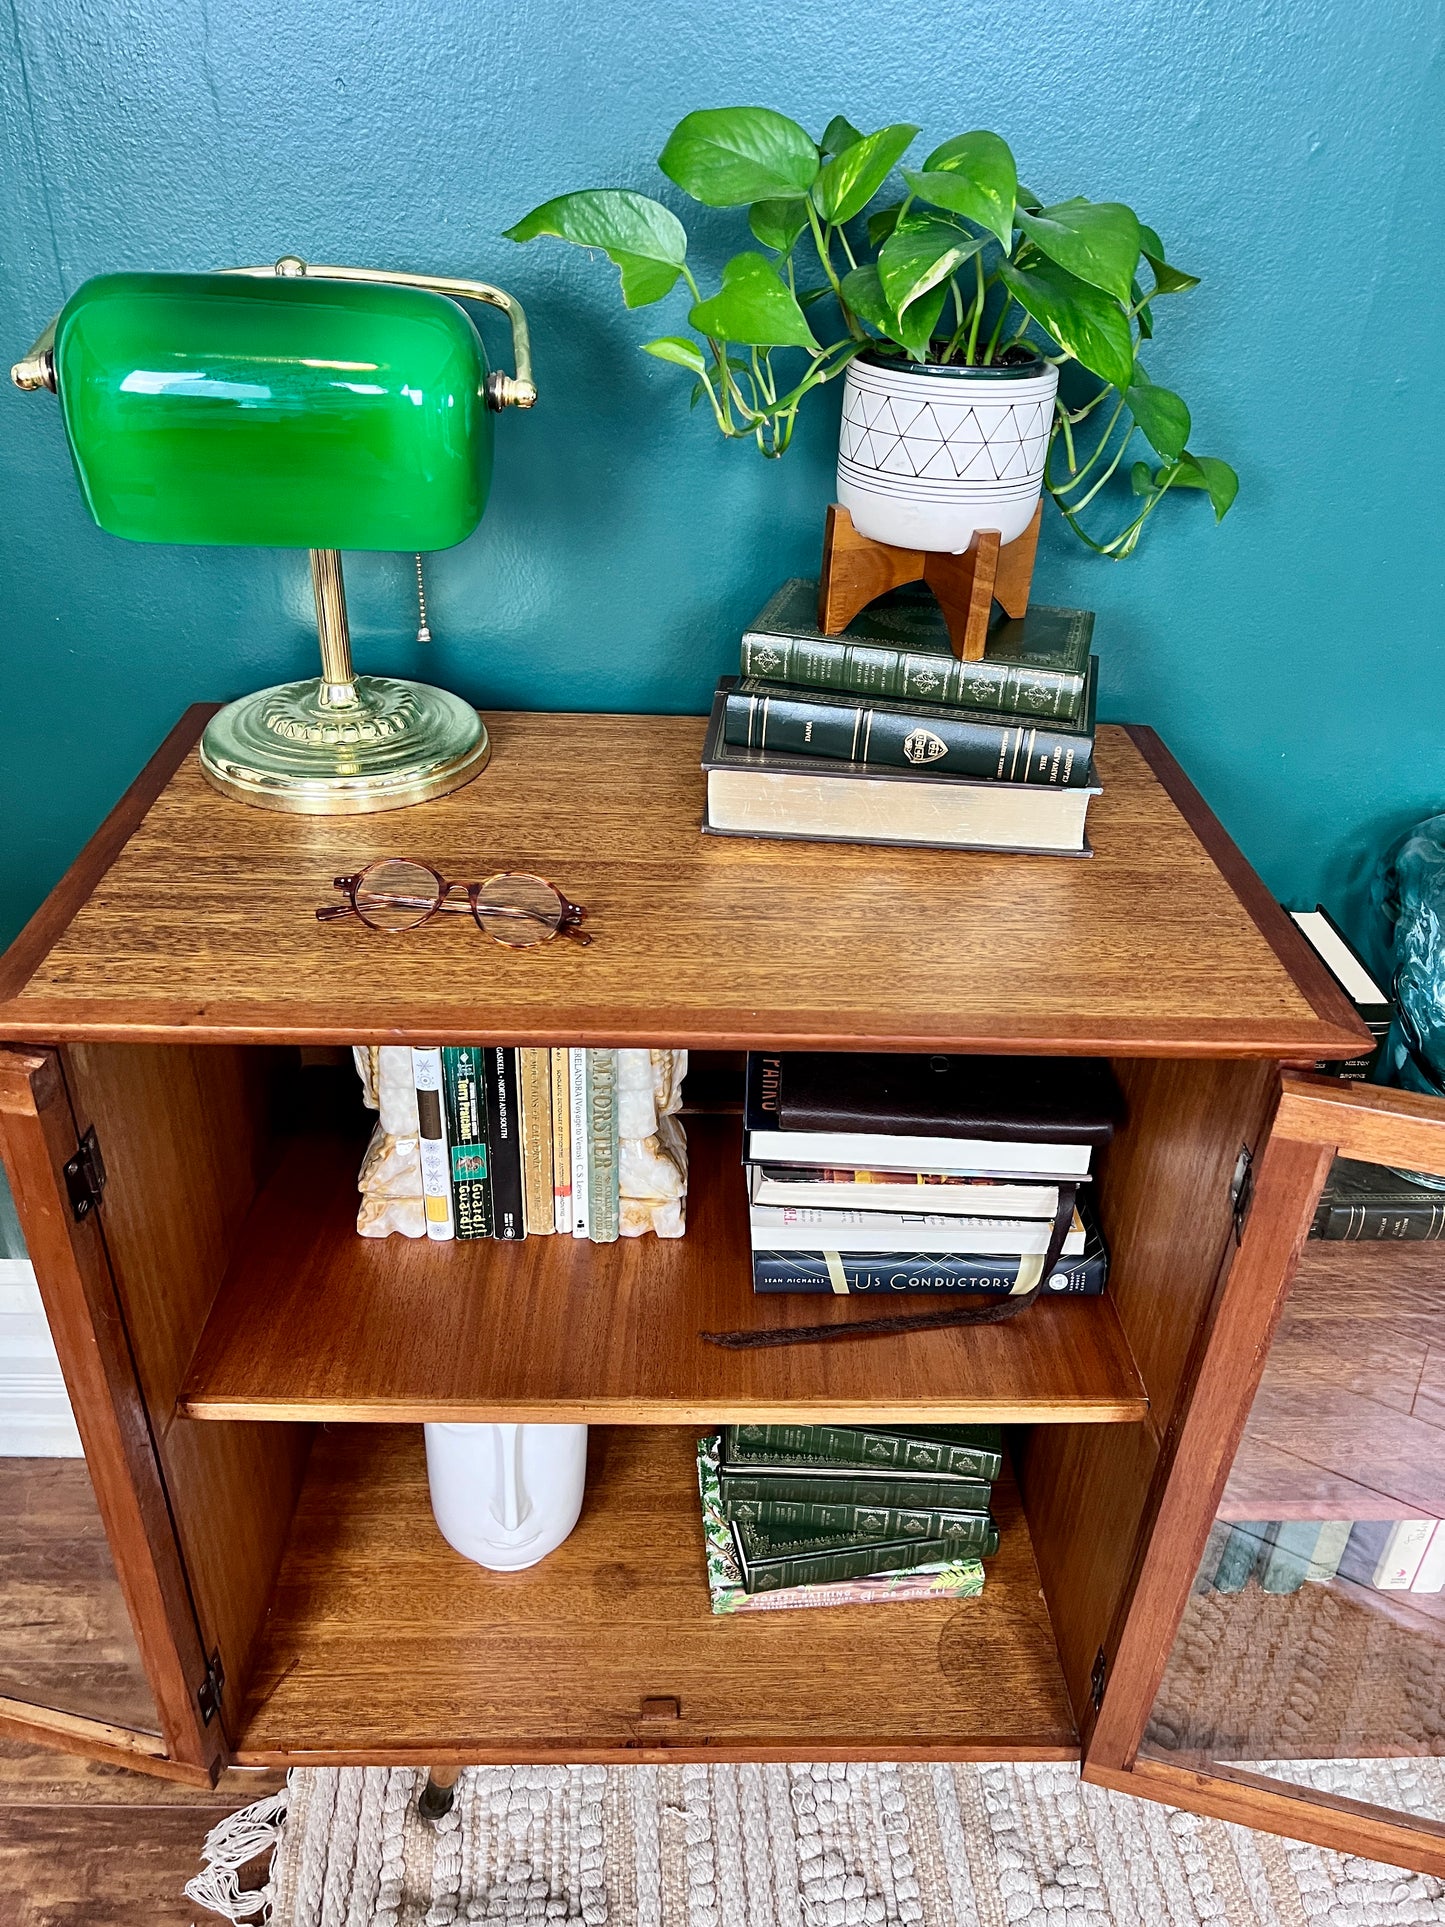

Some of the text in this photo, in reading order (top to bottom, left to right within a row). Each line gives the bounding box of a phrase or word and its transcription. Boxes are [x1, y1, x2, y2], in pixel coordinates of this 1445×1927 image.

[804, 721, 813, 743] DANA
[1038, 754, 1048, 772] THE
[1049, 745, 1062, 782] HARVARD
[1062, 748, 1074, 783] CLASSICS
[573, 1048, 583, 1097] ERELANDRA
[457, 1078, 470, 1102] Terry
[496, 1046, 508, 1139] GASKELL NORTH AND SOUTH
[458, 1102, 473, 1140] Pratchett
[531, 1110, 540, 1122] OF
[573, 1097, 583, 1128] (Voyage
[592, 1083, 613, 1169] FORSTER
[575, 1128, 583, 1136] to
[575, 1136, 584, 1161] Venus)
[576, 1180, 584, 1200] Lewis
[459, 1184, 474, 1236] Guards!
[472, 1183, 487, 1234] Guards!
[594, 1174, 605, 1241] SHORT STORIES
[604, 1185, 613, 1231] COLLECTED
[889, 1273, 1011, 1290] CONDUCTORS
[753, 1593, 796, 1603] FOREST
[801, 1589, 851, 1601] BATHING
